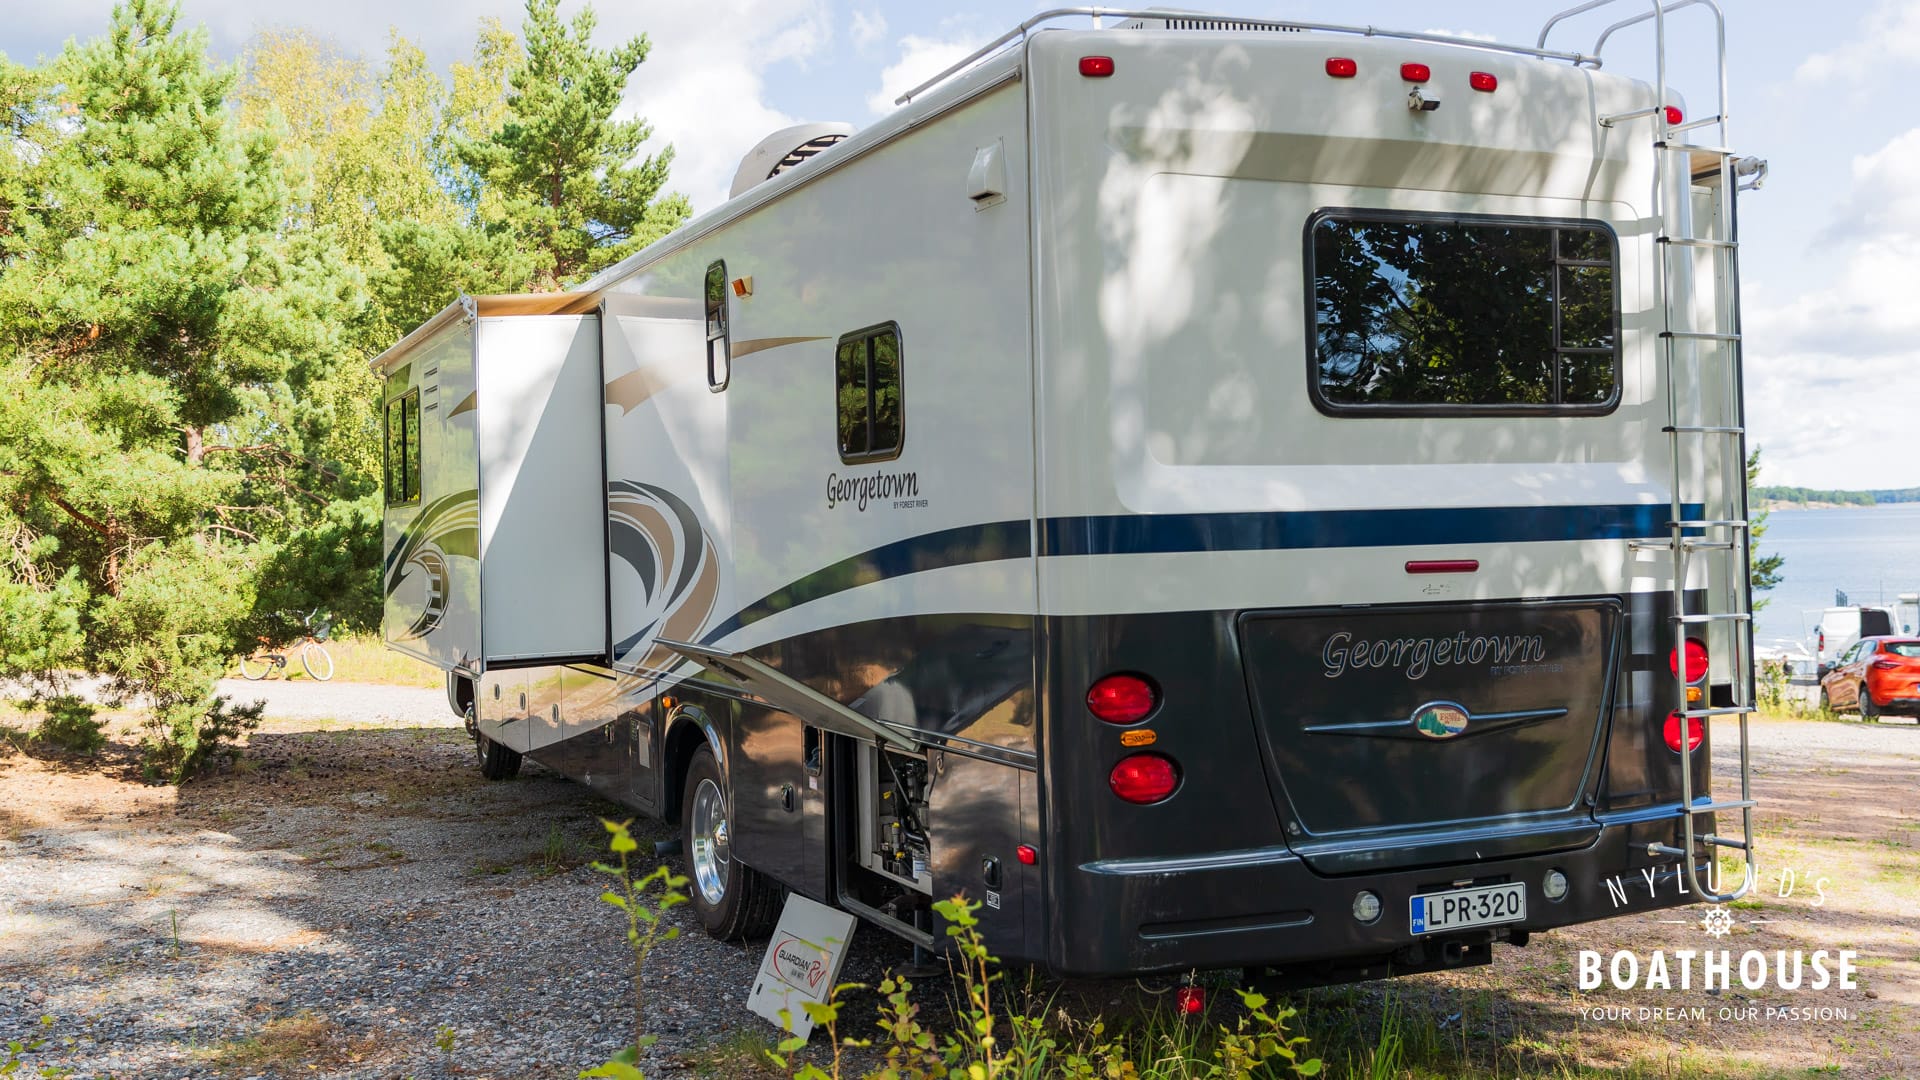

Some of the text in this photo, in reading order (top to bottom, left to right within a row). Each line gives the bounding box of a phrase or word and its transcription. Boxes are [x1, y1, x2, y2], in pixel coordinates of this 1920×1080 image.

[827, 470, 919, 512] Georgetown
[1322, 631, 1546, 680] Georgetown
[1412, 918, 1424, 927] FIN
[1429, 890, 1519, 926] LPR-320
[778, 949, 811, 971] GUARDIAN
